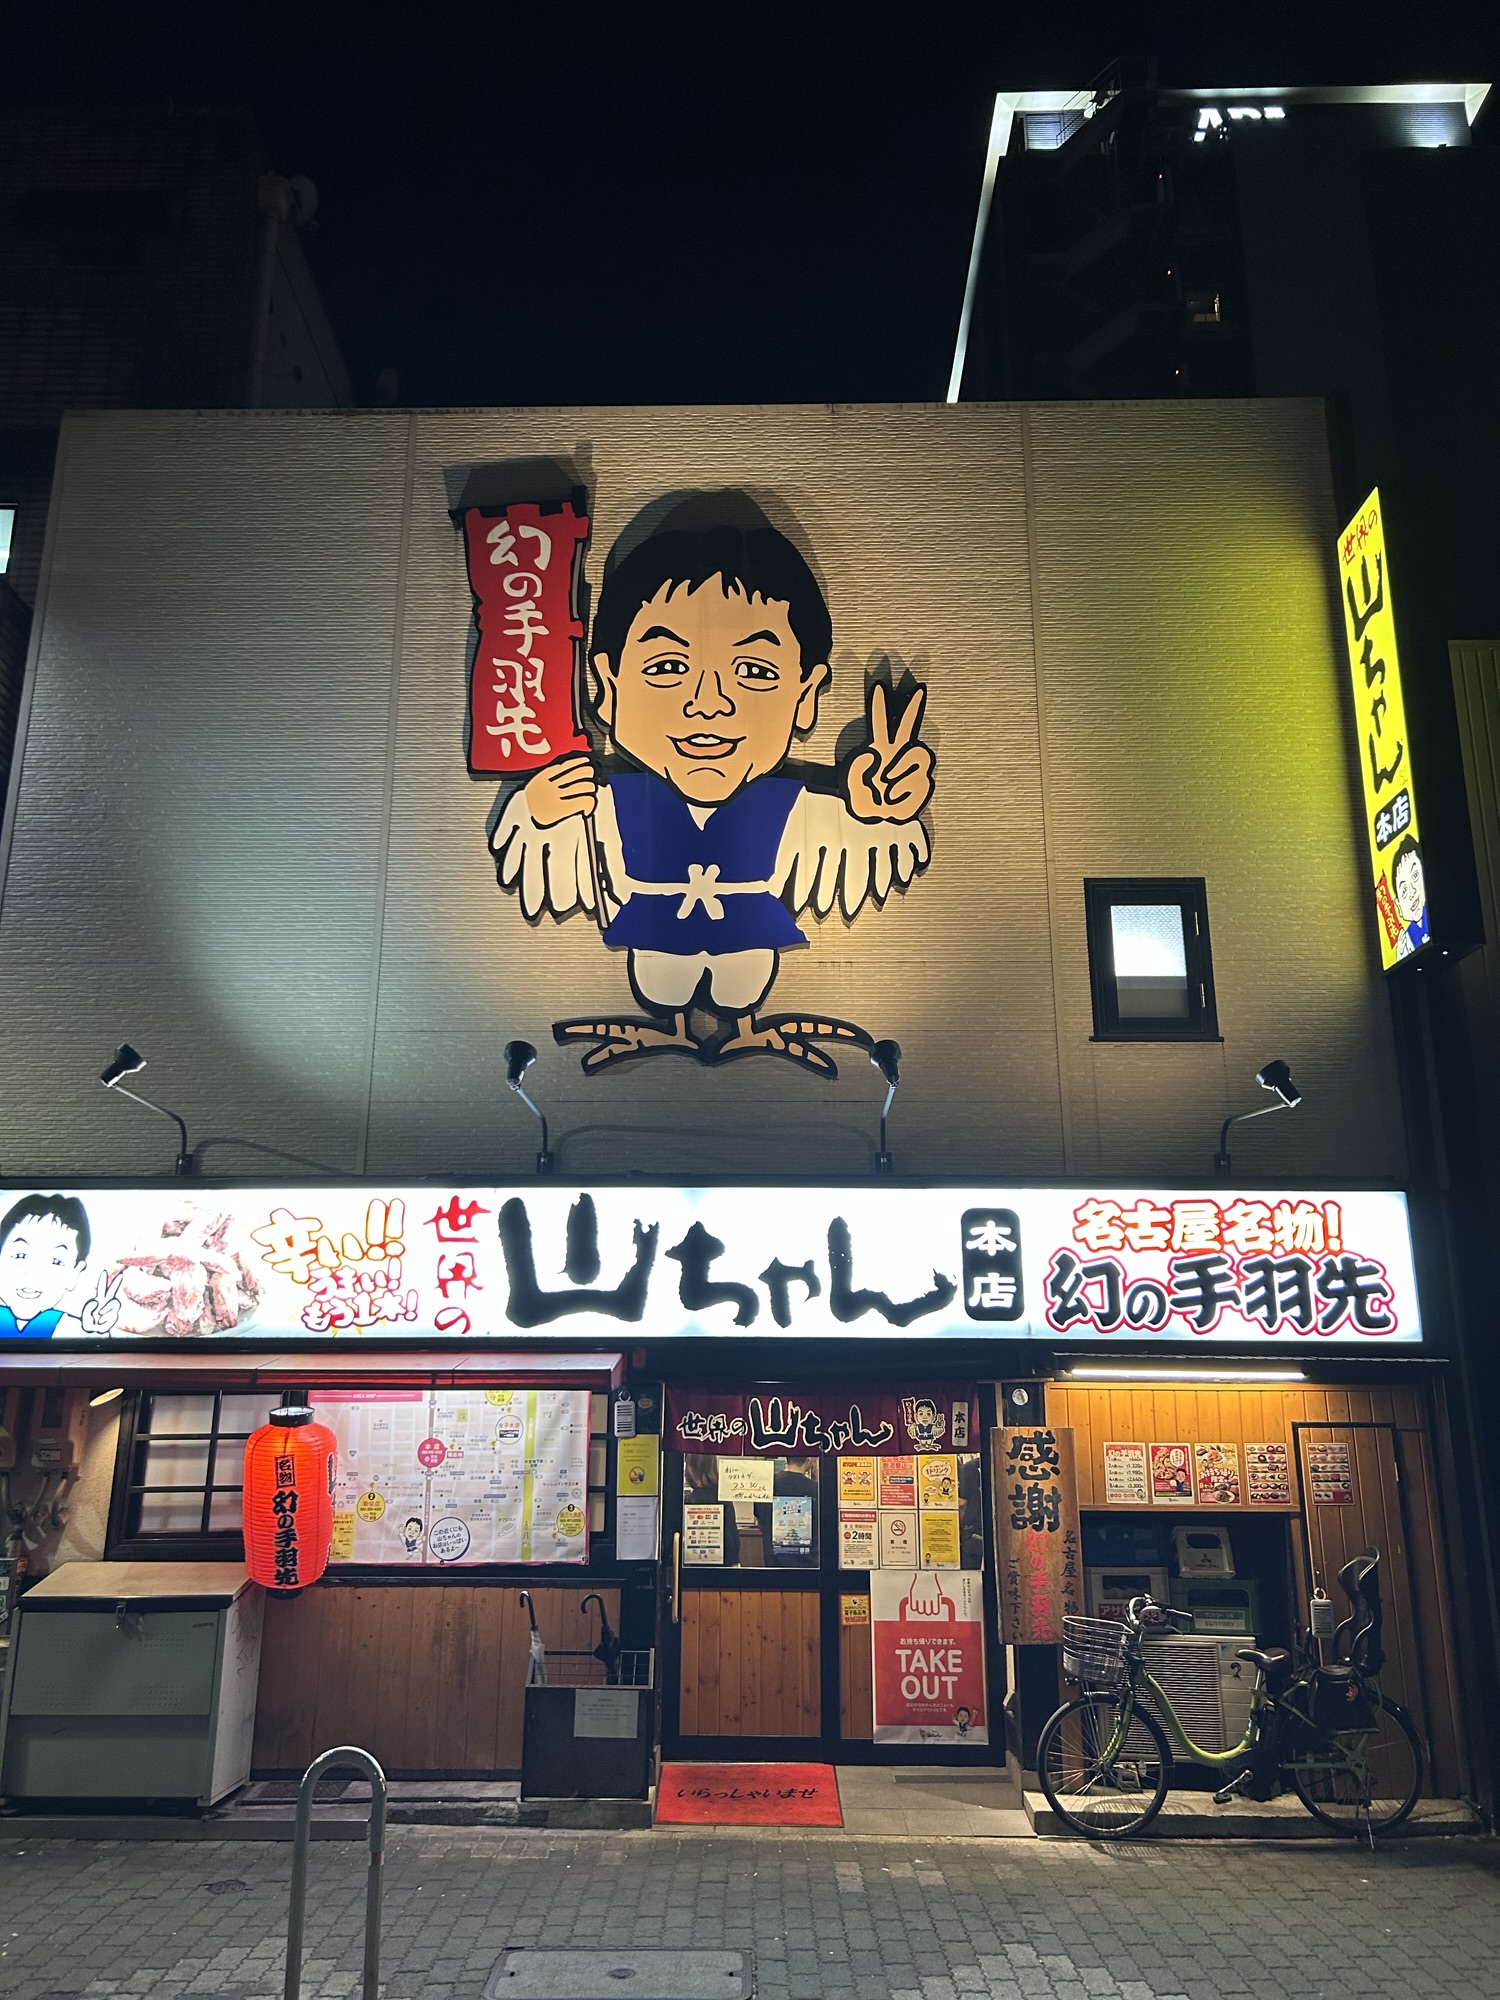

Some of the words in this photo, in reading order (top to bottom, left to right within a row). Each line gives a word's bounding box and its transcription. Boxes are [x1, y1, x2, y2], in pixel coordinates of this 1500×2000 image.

[1342, 509, 1378, 566] 世界の
[486, 520, 552, 758] 幻の手羽先
[1347, 549, 1404, 794] 山ちゃん
[1376, 794, 1410, 844] 本店
[422, 1195, 492, 1334] 世界の
[497, 1192, 958, 1328] 山ちゃん
[965, 1219, 1018, 1309] 本店
[1046, 1248, 1394, 1334] 幻の手羽先
[676, 1411, 748, 1444] 世界の
[749, 1397, 894, 1453] 山ちゃん
[954, 1410, 966, 1439] 本店
[278, 1459, 293, 1485] 名物
[1006, 1430, 1062, 1533] 感謝
[272, 1490, 299, 1586] 幻の手羽先
[437, 1533, 462, 1542] 山ちゃんの
[852, 1530, 873, 1540] 2時間
[1006, 1558, 1024, 1640] ご賞味下さい
[1025, 1532, 1055, 1641] 幻の手羽先
[1061, 1530, 1079, 1615] 名古屋名物
[895, 1649, 964, 1673] TAKE
[899, 1637, 956, 1646] お持ち帰りできます。
[901, 1675, 959, 1700] OUT
[677, 1787, 819, 1800] いらっしゃいませ
